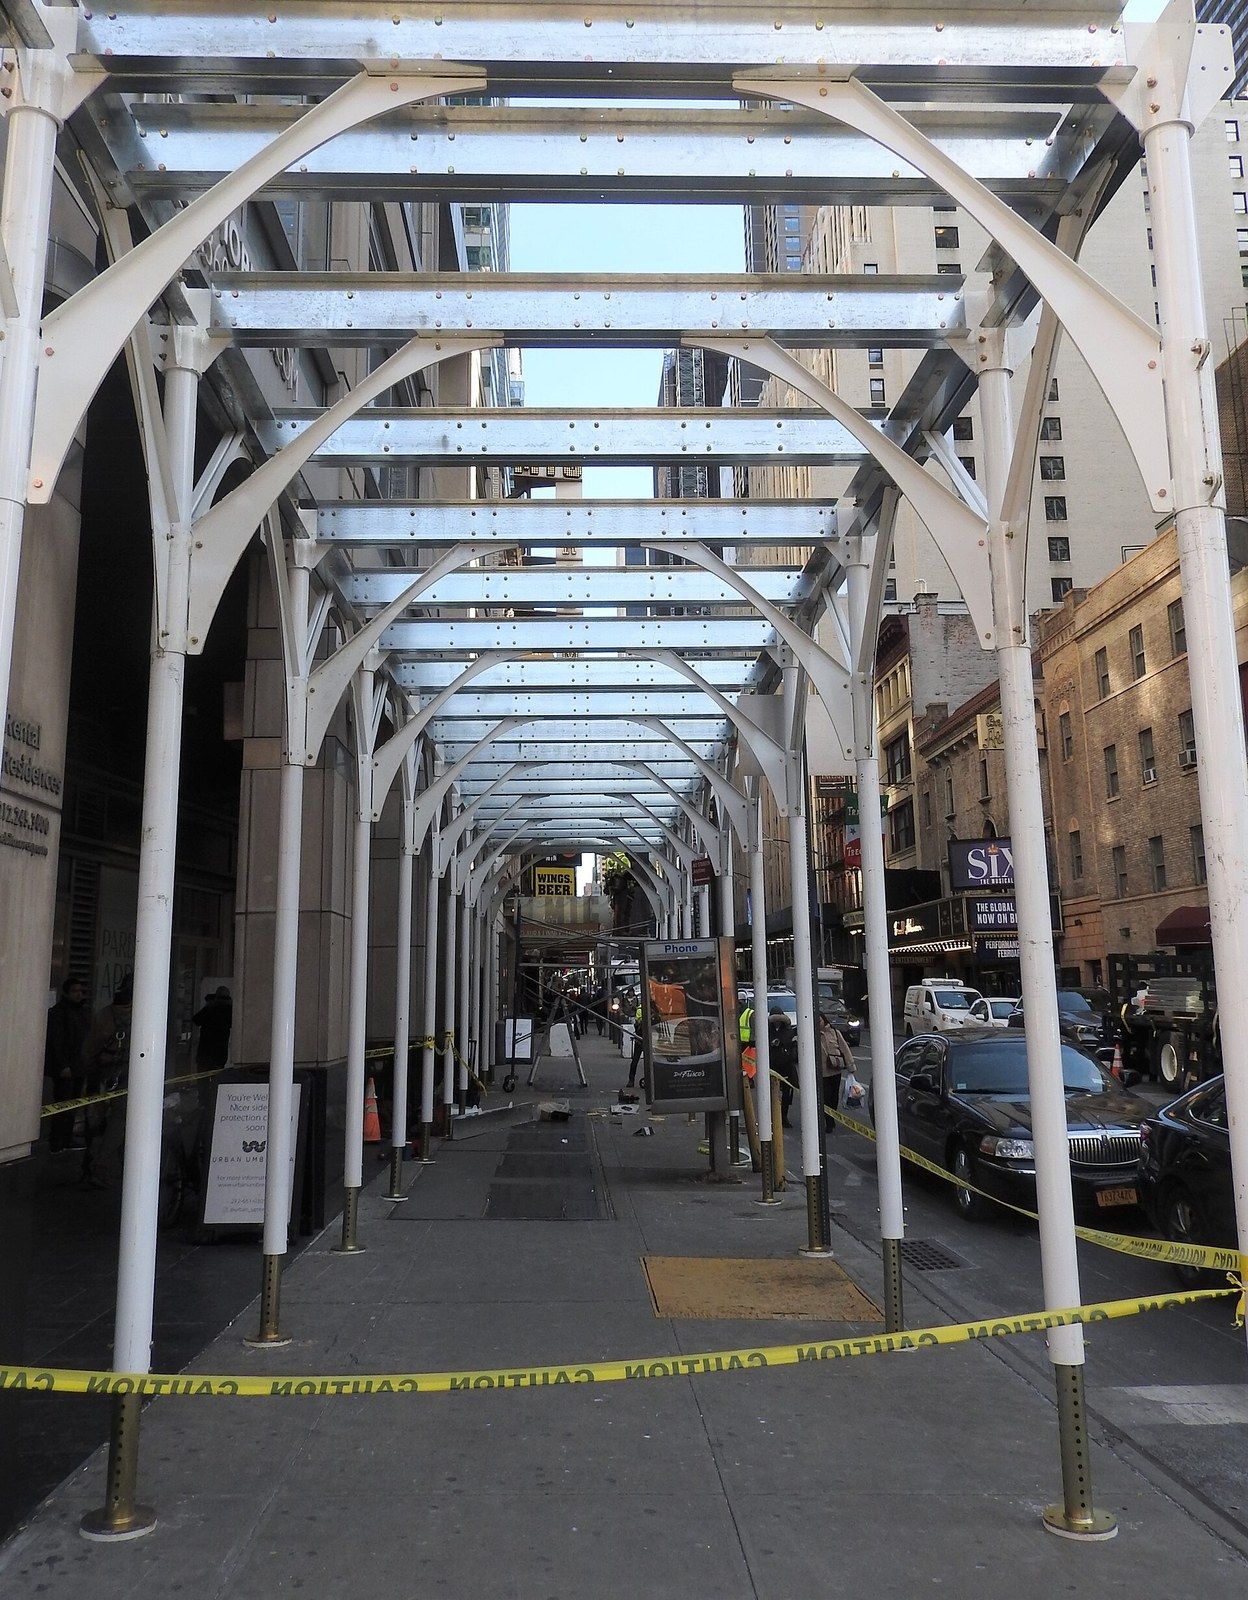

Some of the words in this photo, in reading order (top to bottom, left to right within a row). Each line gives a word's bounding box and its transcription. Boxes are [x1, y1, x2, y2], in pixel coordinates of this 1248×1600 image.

[537, 873, 573, 884] WINGS.
[537, 884, 573, 896] BEER.
[976, 902, 989, 912] THE
[990, 902, 1015, 912] GLOBAL
[976, 913, 995, 924] NOW
[997, 913, 1008, 924] ON
[664, 944, 698, 954] Phone
[227, 1094, 251, 1102] You're
[230, 1104, 249, 1112] Nicer
[220, 1114, 261, 1122] protection
